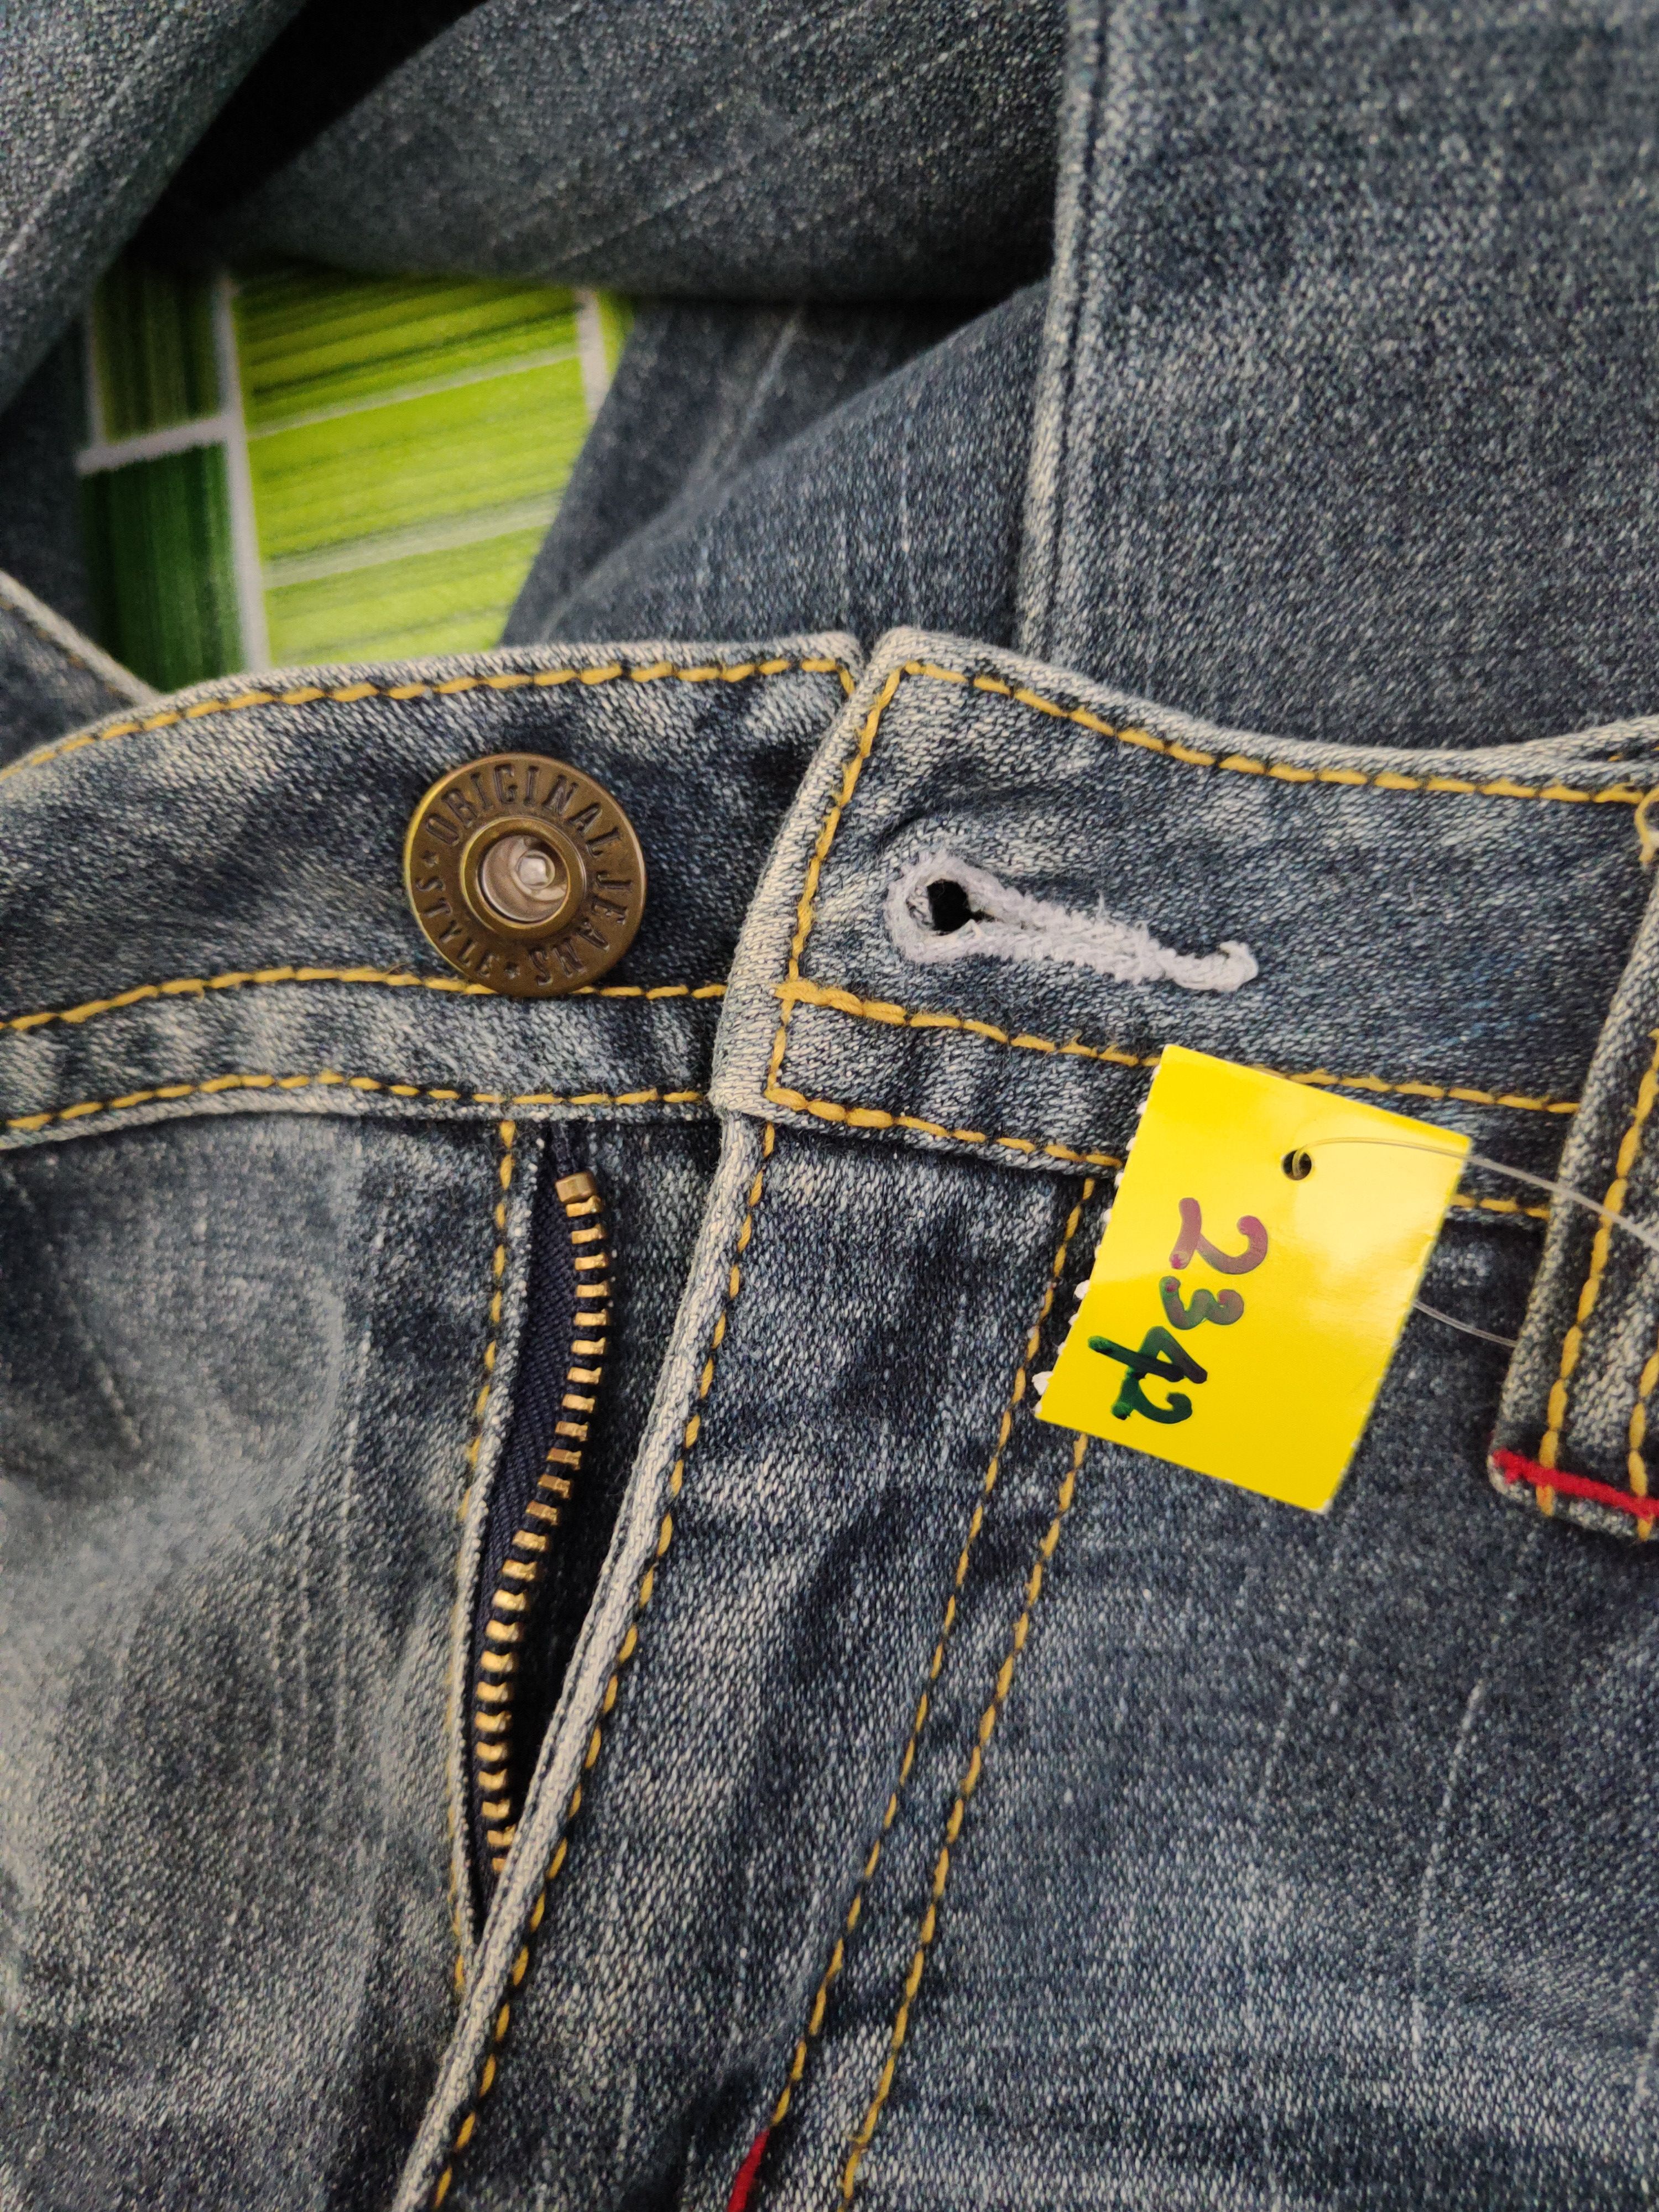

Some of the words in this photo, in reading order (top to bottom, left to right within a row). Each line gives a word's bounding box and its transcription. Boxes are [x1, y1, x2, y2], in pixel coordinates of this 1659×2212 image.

[415, 876, 495, 978] STYLE
[425, 763, 622, 859] ORIGINAL
[528, 870, 633, 987] JEANS
